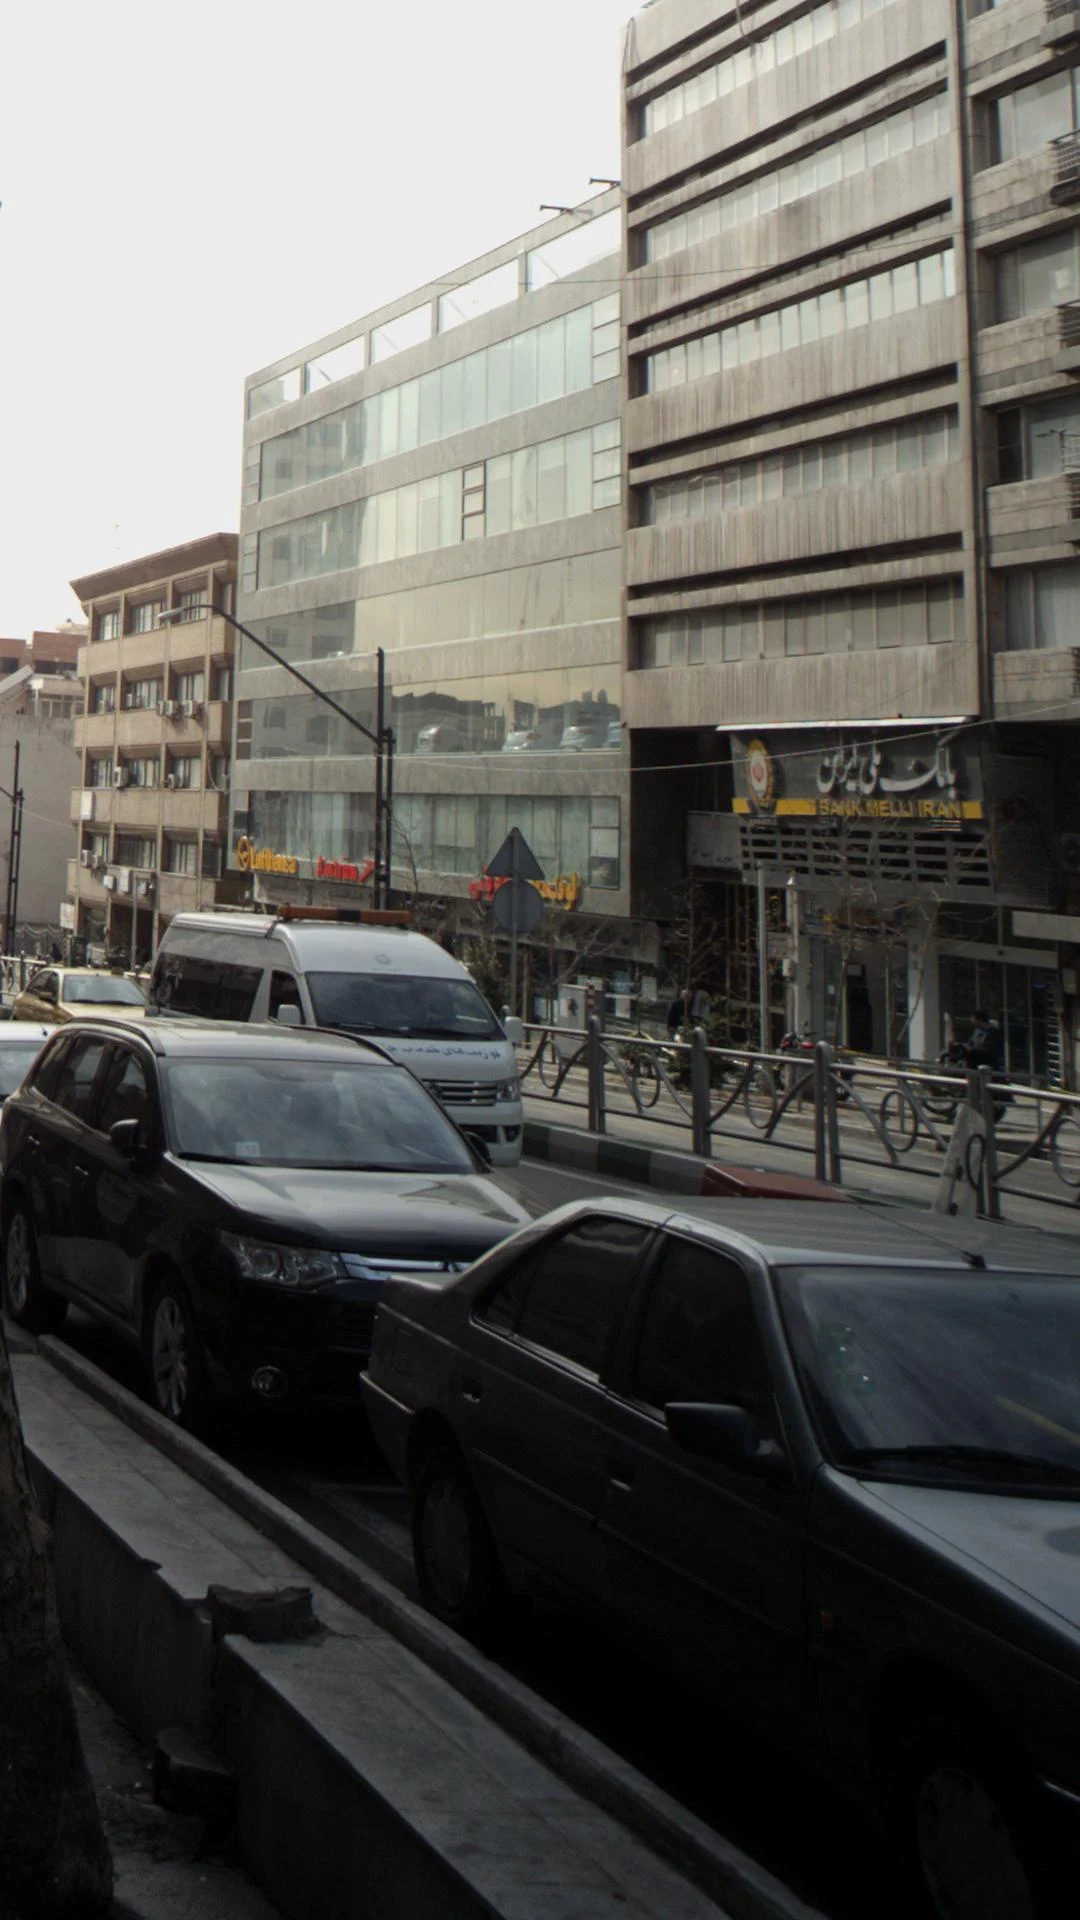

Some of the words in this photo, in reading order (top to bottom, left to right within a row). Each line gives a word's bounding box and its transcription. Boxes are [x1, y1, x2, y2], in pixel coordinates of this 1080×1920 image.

[819, 799, 863, 817] BANK
[867, 799, 915, 818] MELLI
[918, 800, 962, 819] IRAN
